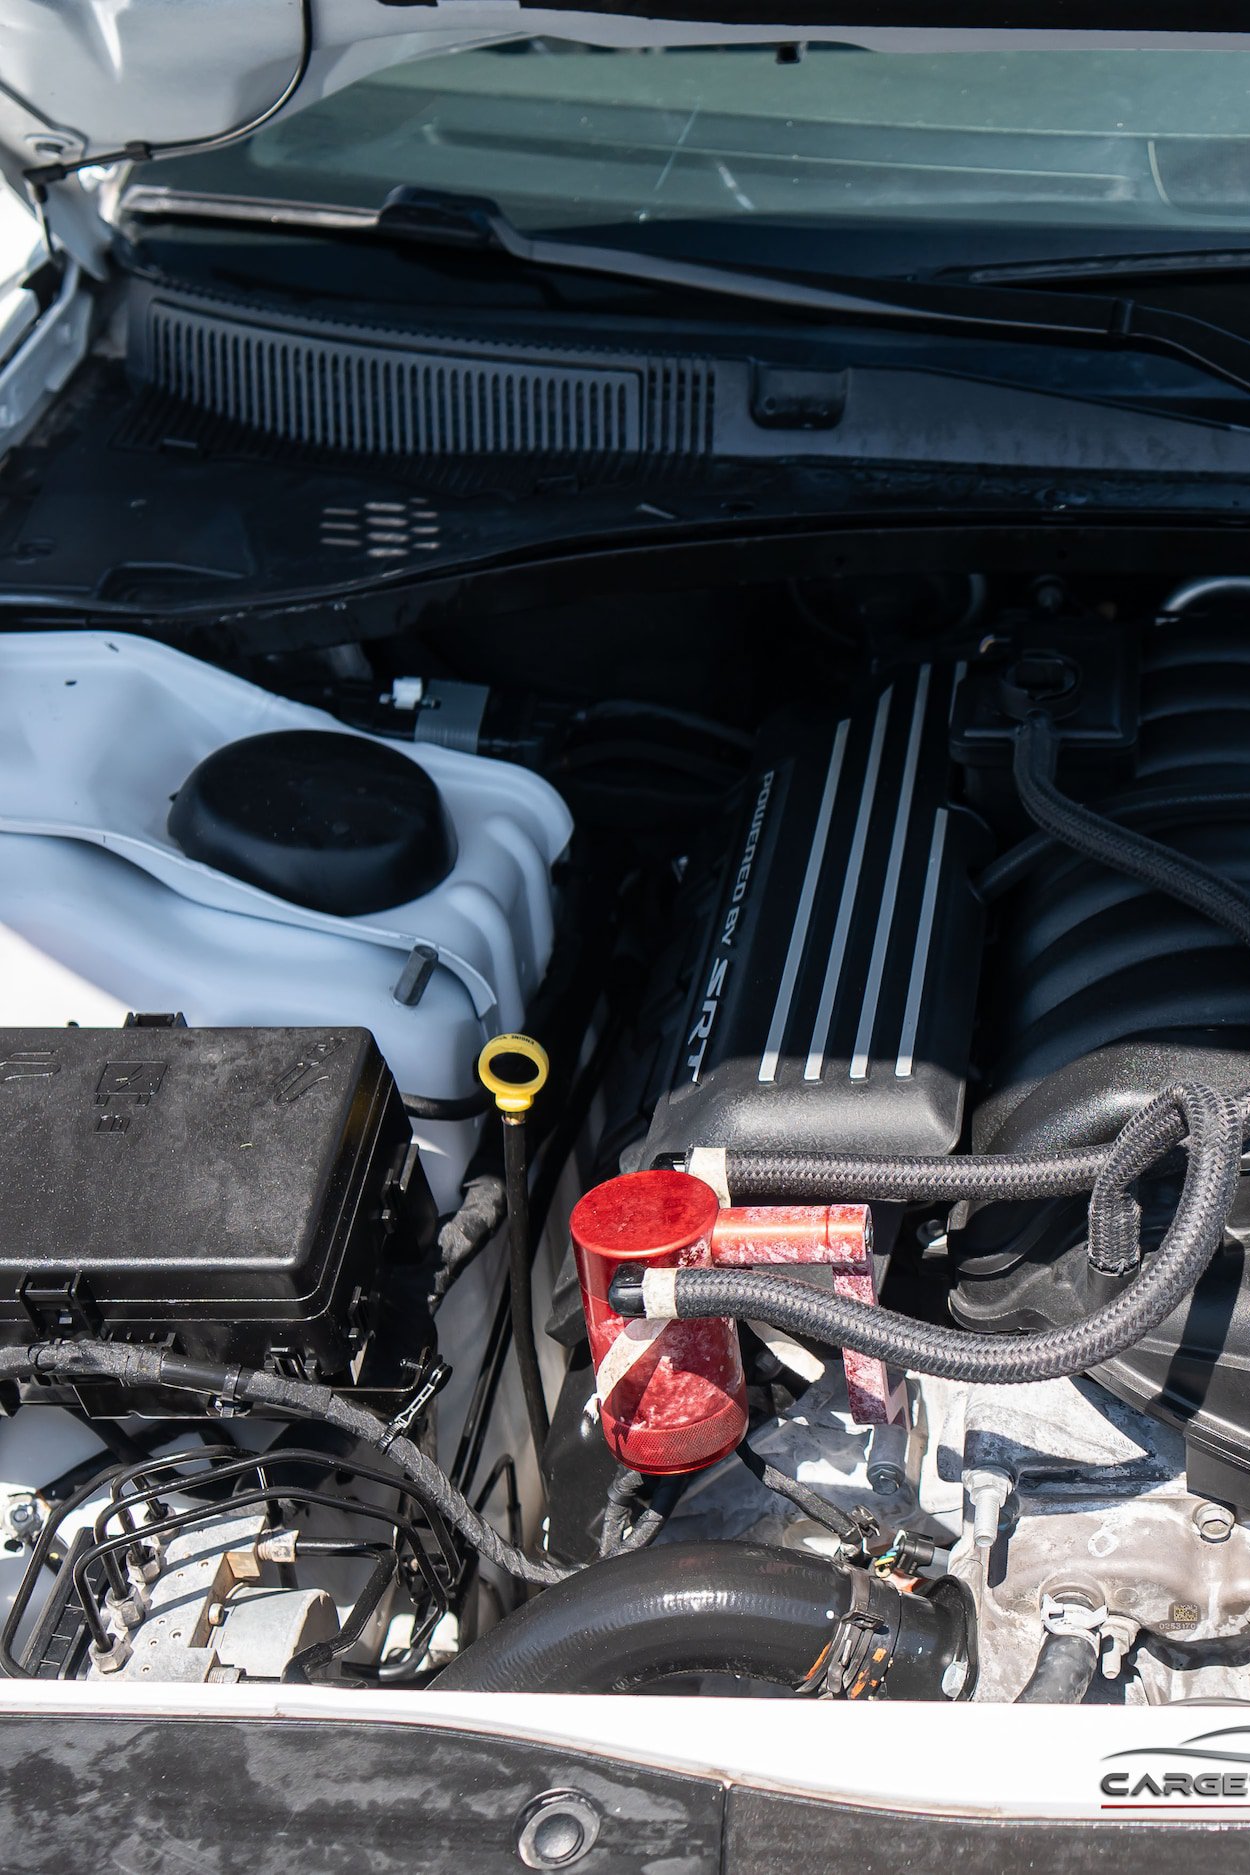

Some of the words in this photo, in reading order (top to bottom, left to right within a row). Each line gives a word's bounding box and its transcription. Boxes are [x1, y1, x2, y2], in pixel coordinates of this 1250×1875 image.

[732, 770, 775, 902] POWERED
[721, 906, 740, 946] BY
[687, 957, 729, 1083] SRT
